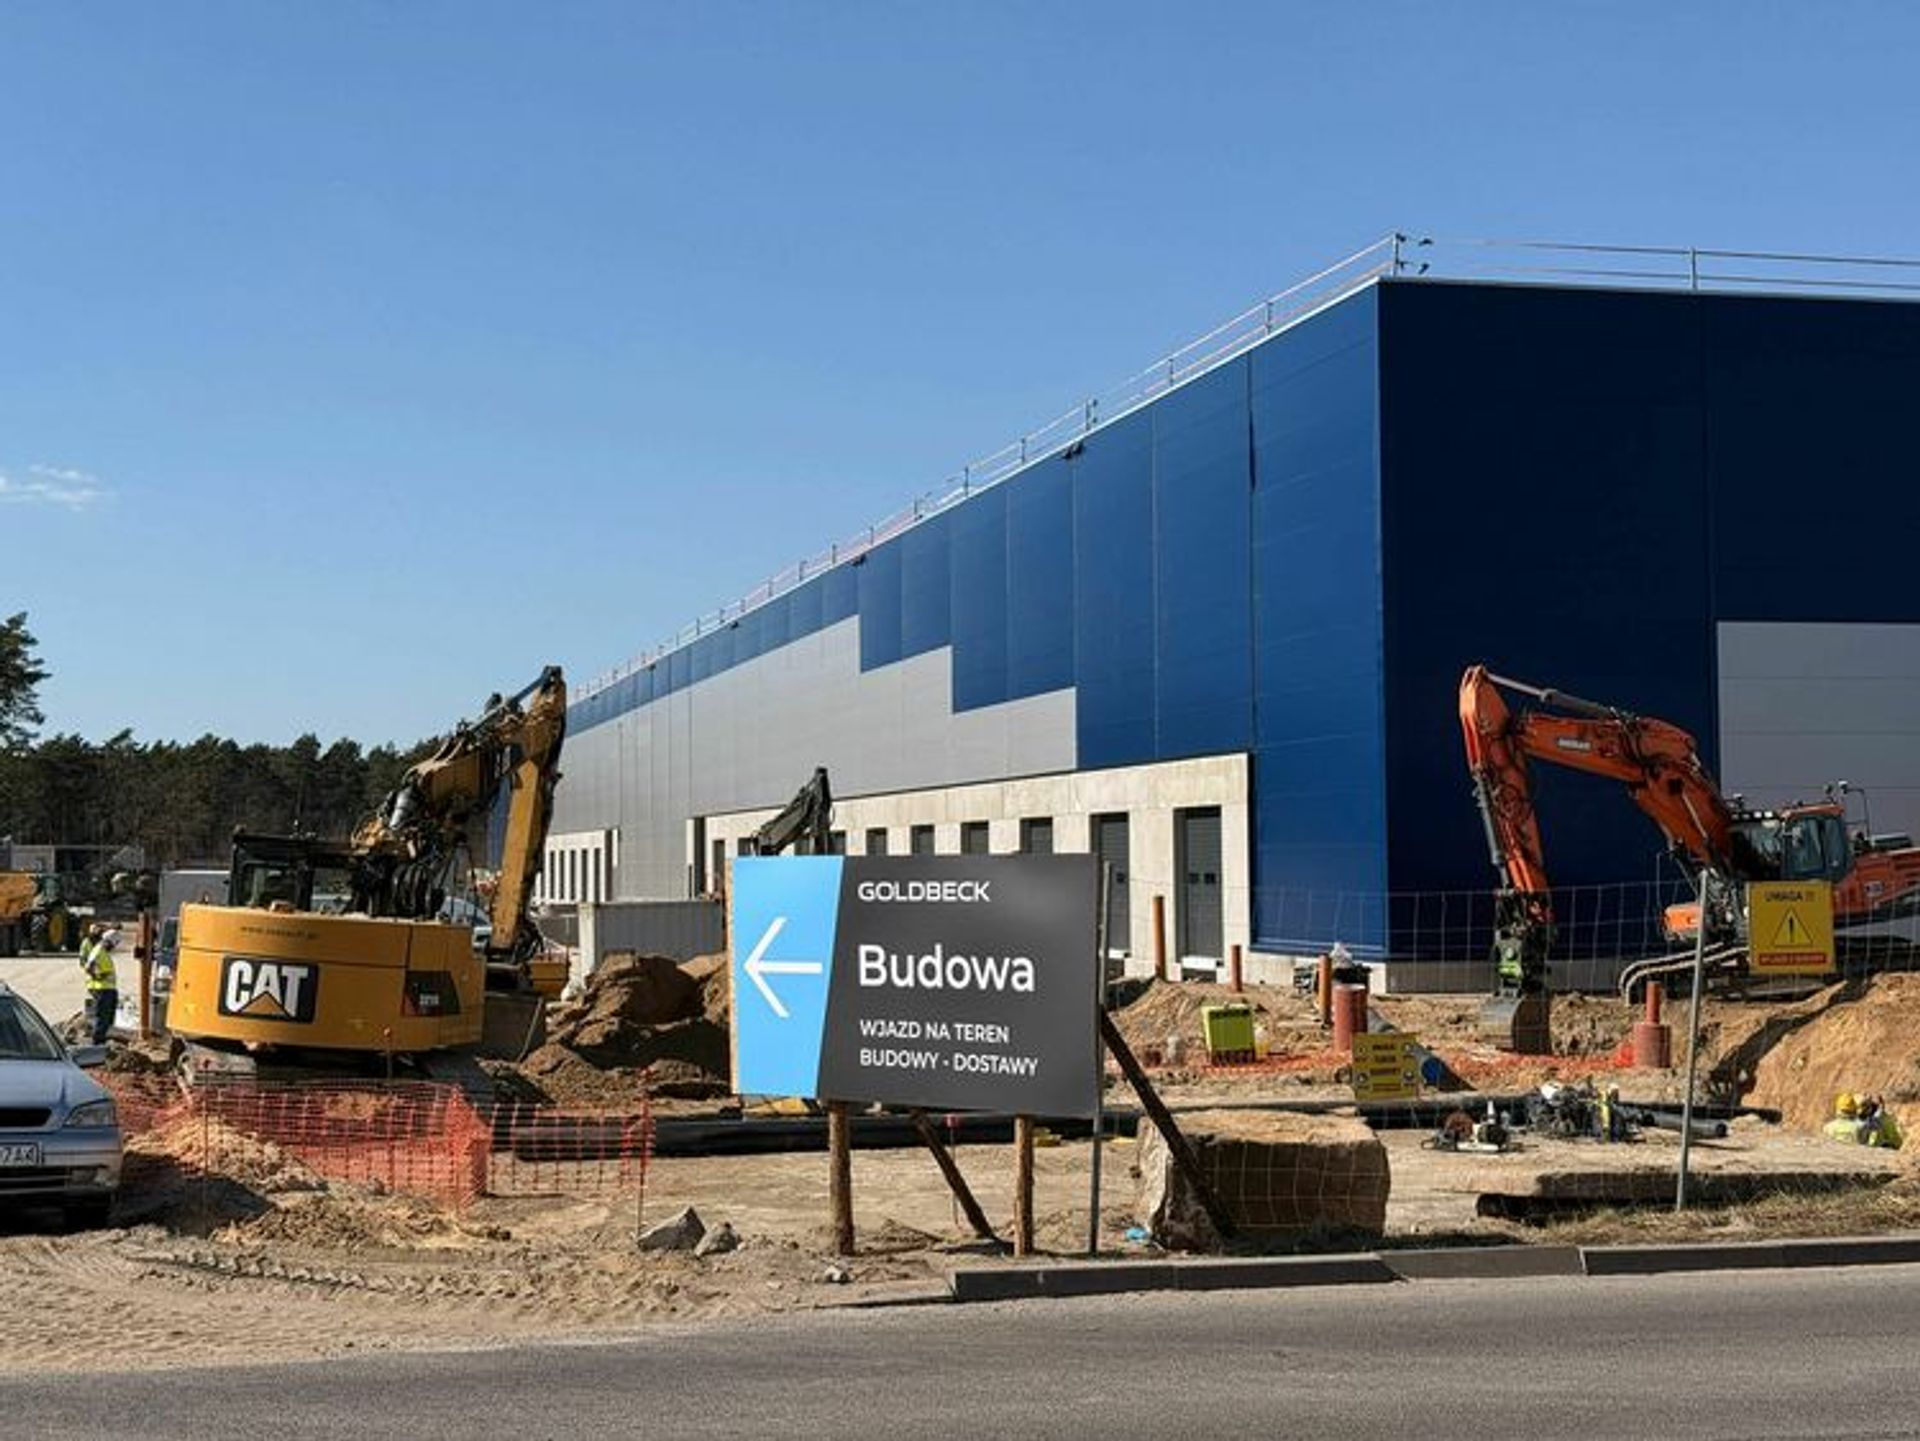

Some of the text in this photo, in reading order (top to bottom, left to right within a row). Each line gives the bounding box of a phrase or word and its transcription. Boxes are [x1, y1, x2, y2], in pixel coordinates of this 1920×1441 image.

[857, 881, 992, 903] GOLDBECK
[858, 943, 1036, 992] Budowa
[227, 960, 309, 1017] CAT
[860, 1019, 1010, 1044] WJAZD NA TEREN
[860, 1048, 939, 1069] BUDOWY
[952, 1055, 1039, 1076] DOSTAWY
